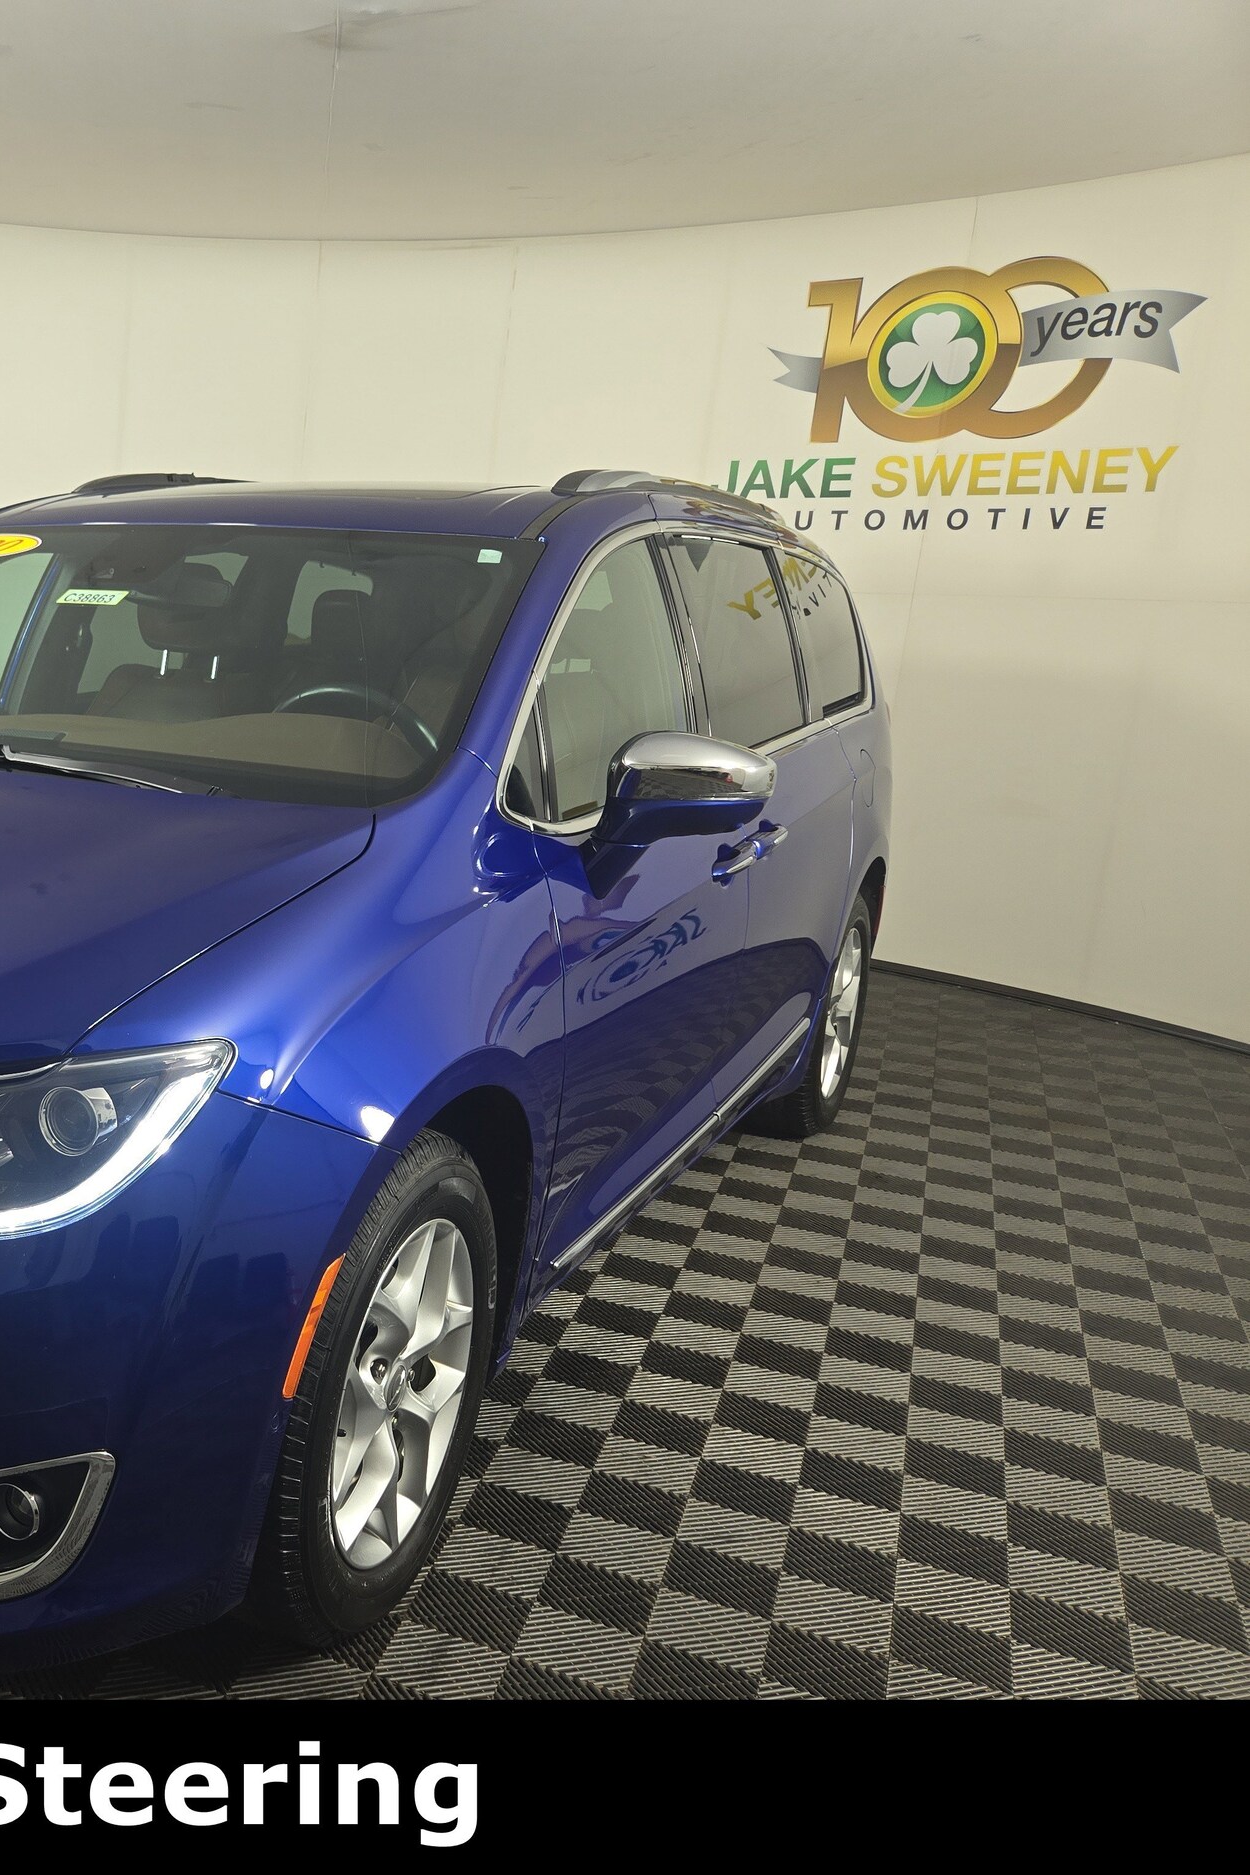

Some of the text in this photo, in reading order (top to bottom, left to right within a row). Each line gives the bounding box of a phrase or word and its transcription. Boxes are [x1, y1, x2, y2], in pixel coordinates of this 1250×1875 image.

[807, 255, 1163, 443] 100 years
[711, 444, 1180, 499] JAKE SWEENEY
[794, 506, 1108, 531] UTOMOTIVE
[64, 592, 116, 604] C38863
